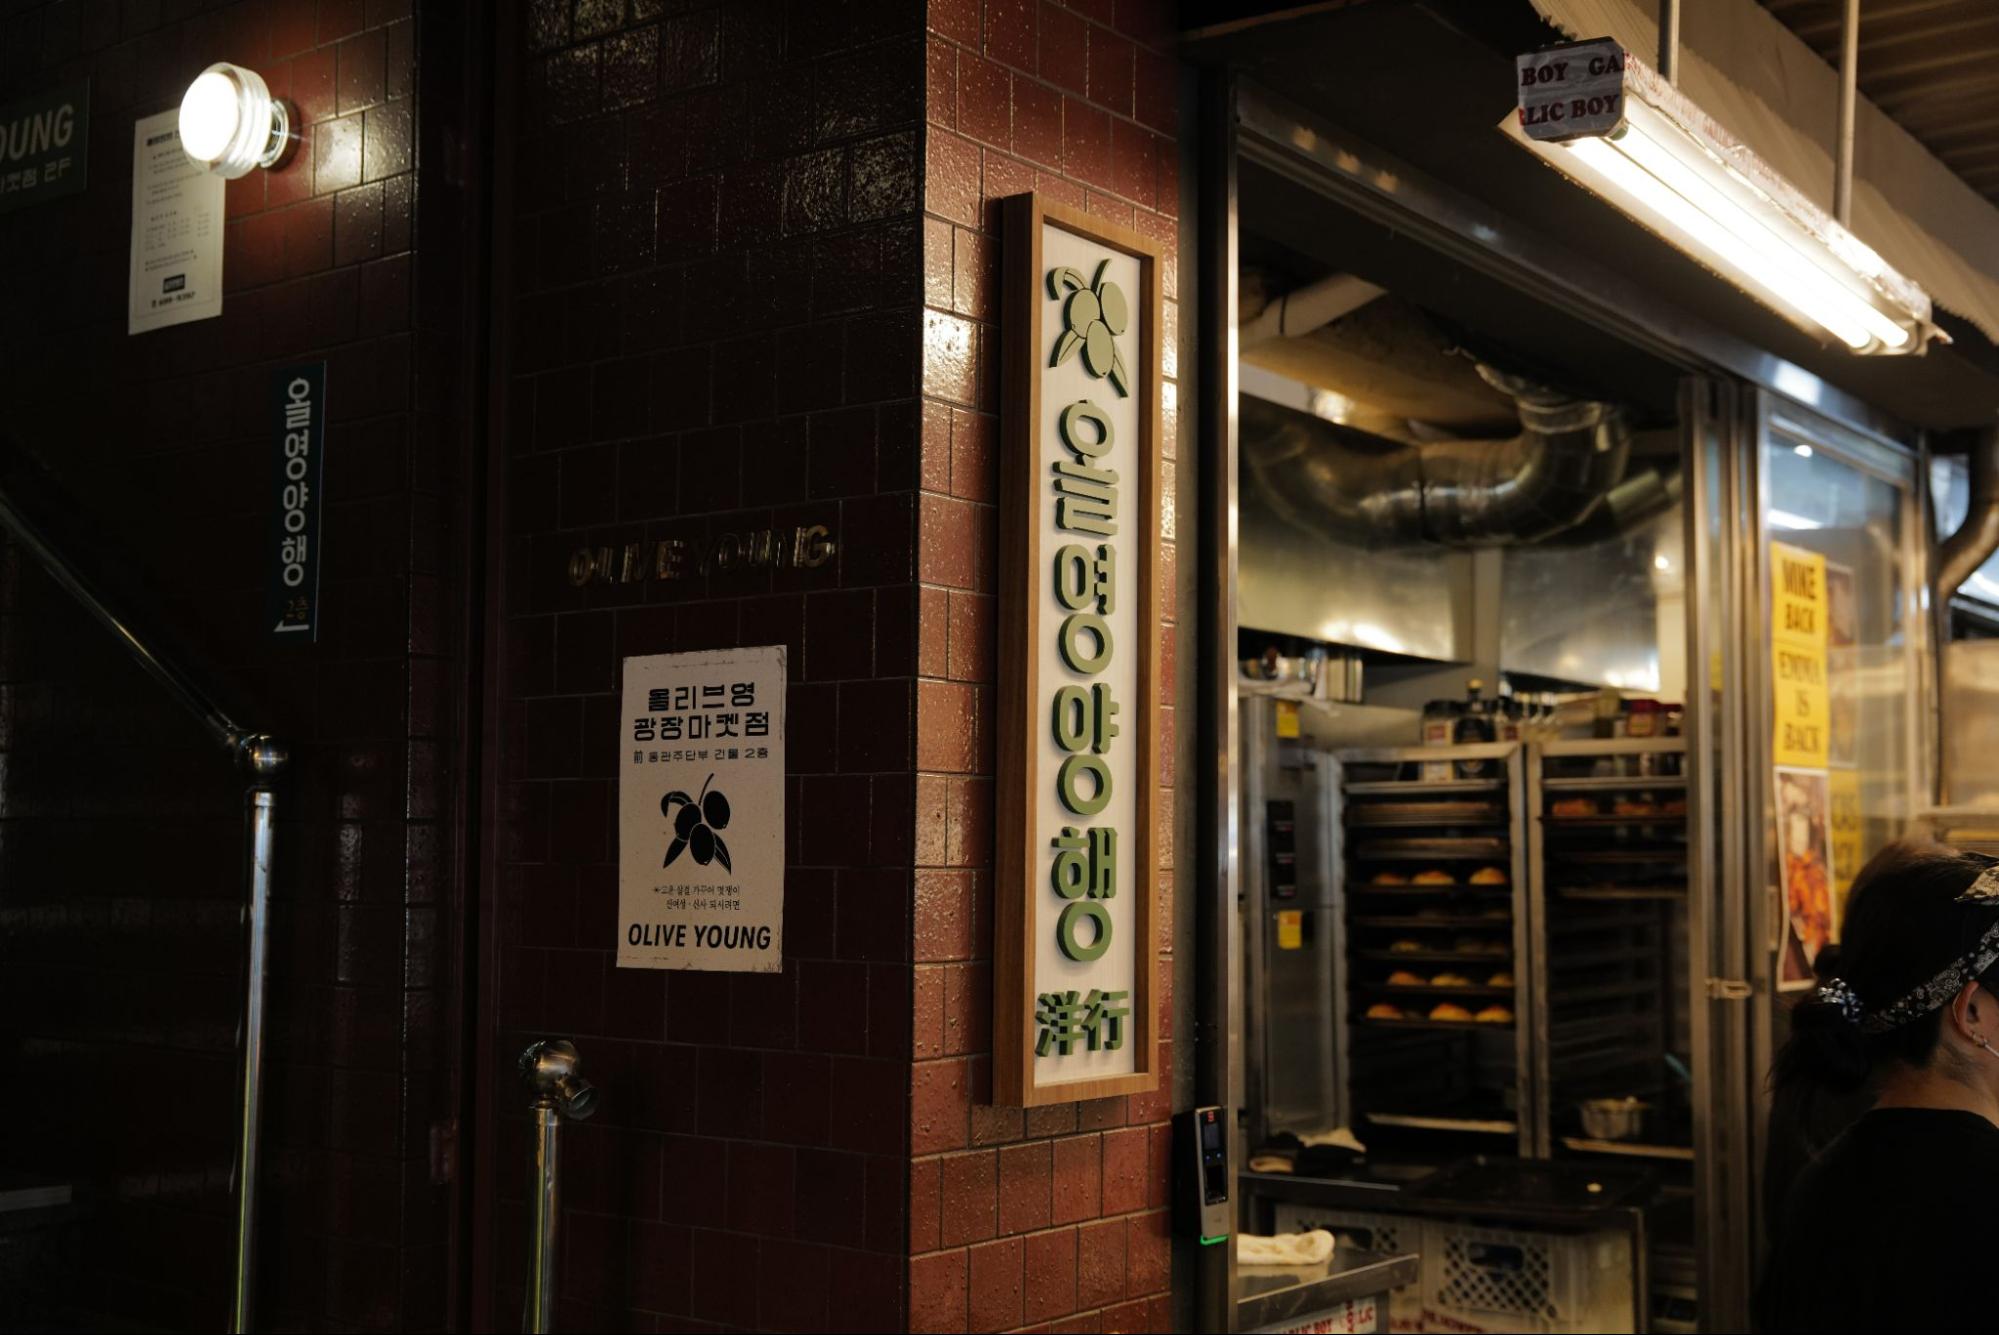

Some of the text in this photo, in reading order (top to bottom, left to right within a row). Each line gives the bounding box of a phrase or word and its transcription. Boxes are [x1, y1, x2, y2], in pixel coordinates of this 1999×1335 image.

[1521, 62, 1568, 86] BOY
[1519, 94, 1619, 126] LIC BOY
[281, 377, 312, 588] 올영양행
[566, 524, 838, 587] OLIVE YOUNG
[1051, 400, 1120, 962] 올영양행
[648, 682, 755, 713] 올리브영
[633, 711, 769, 742] 광장마켓점
[745, 747, 768, 759] 2층
[628, 923, 771, 950] OLIVE YOUNG
[1035, 988, 1130, 1058] 洋行
